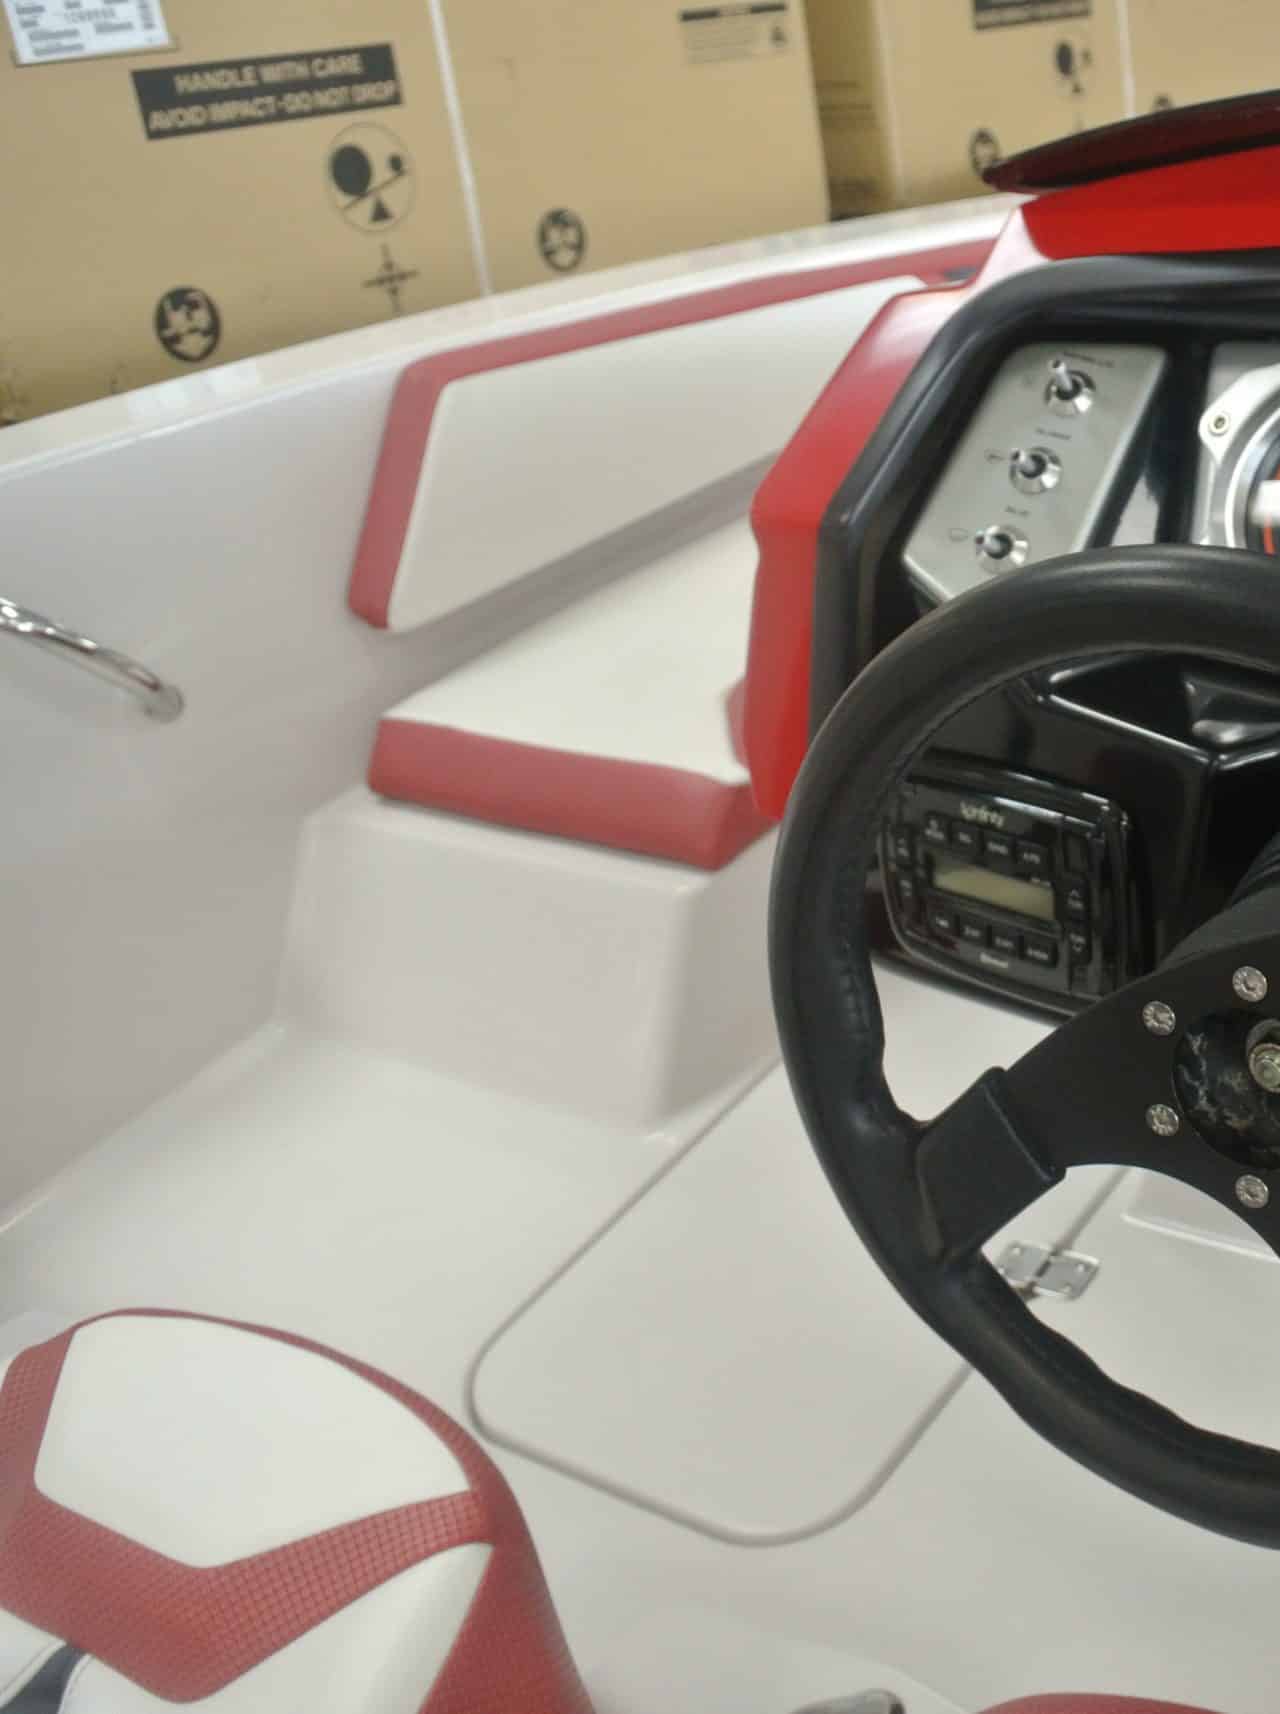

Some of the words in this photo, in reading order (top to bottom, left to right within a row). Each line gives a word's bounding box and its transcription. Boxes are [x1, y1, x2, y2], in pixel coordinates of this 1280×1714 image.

[174, 65, 258, 95] HANDLE
[259, 60, 311, 84] WITH
[311, 53, 364, 78] CARE
[149, 105, 208, 130] AVOID
[351, 79, 398, 102] DROP
